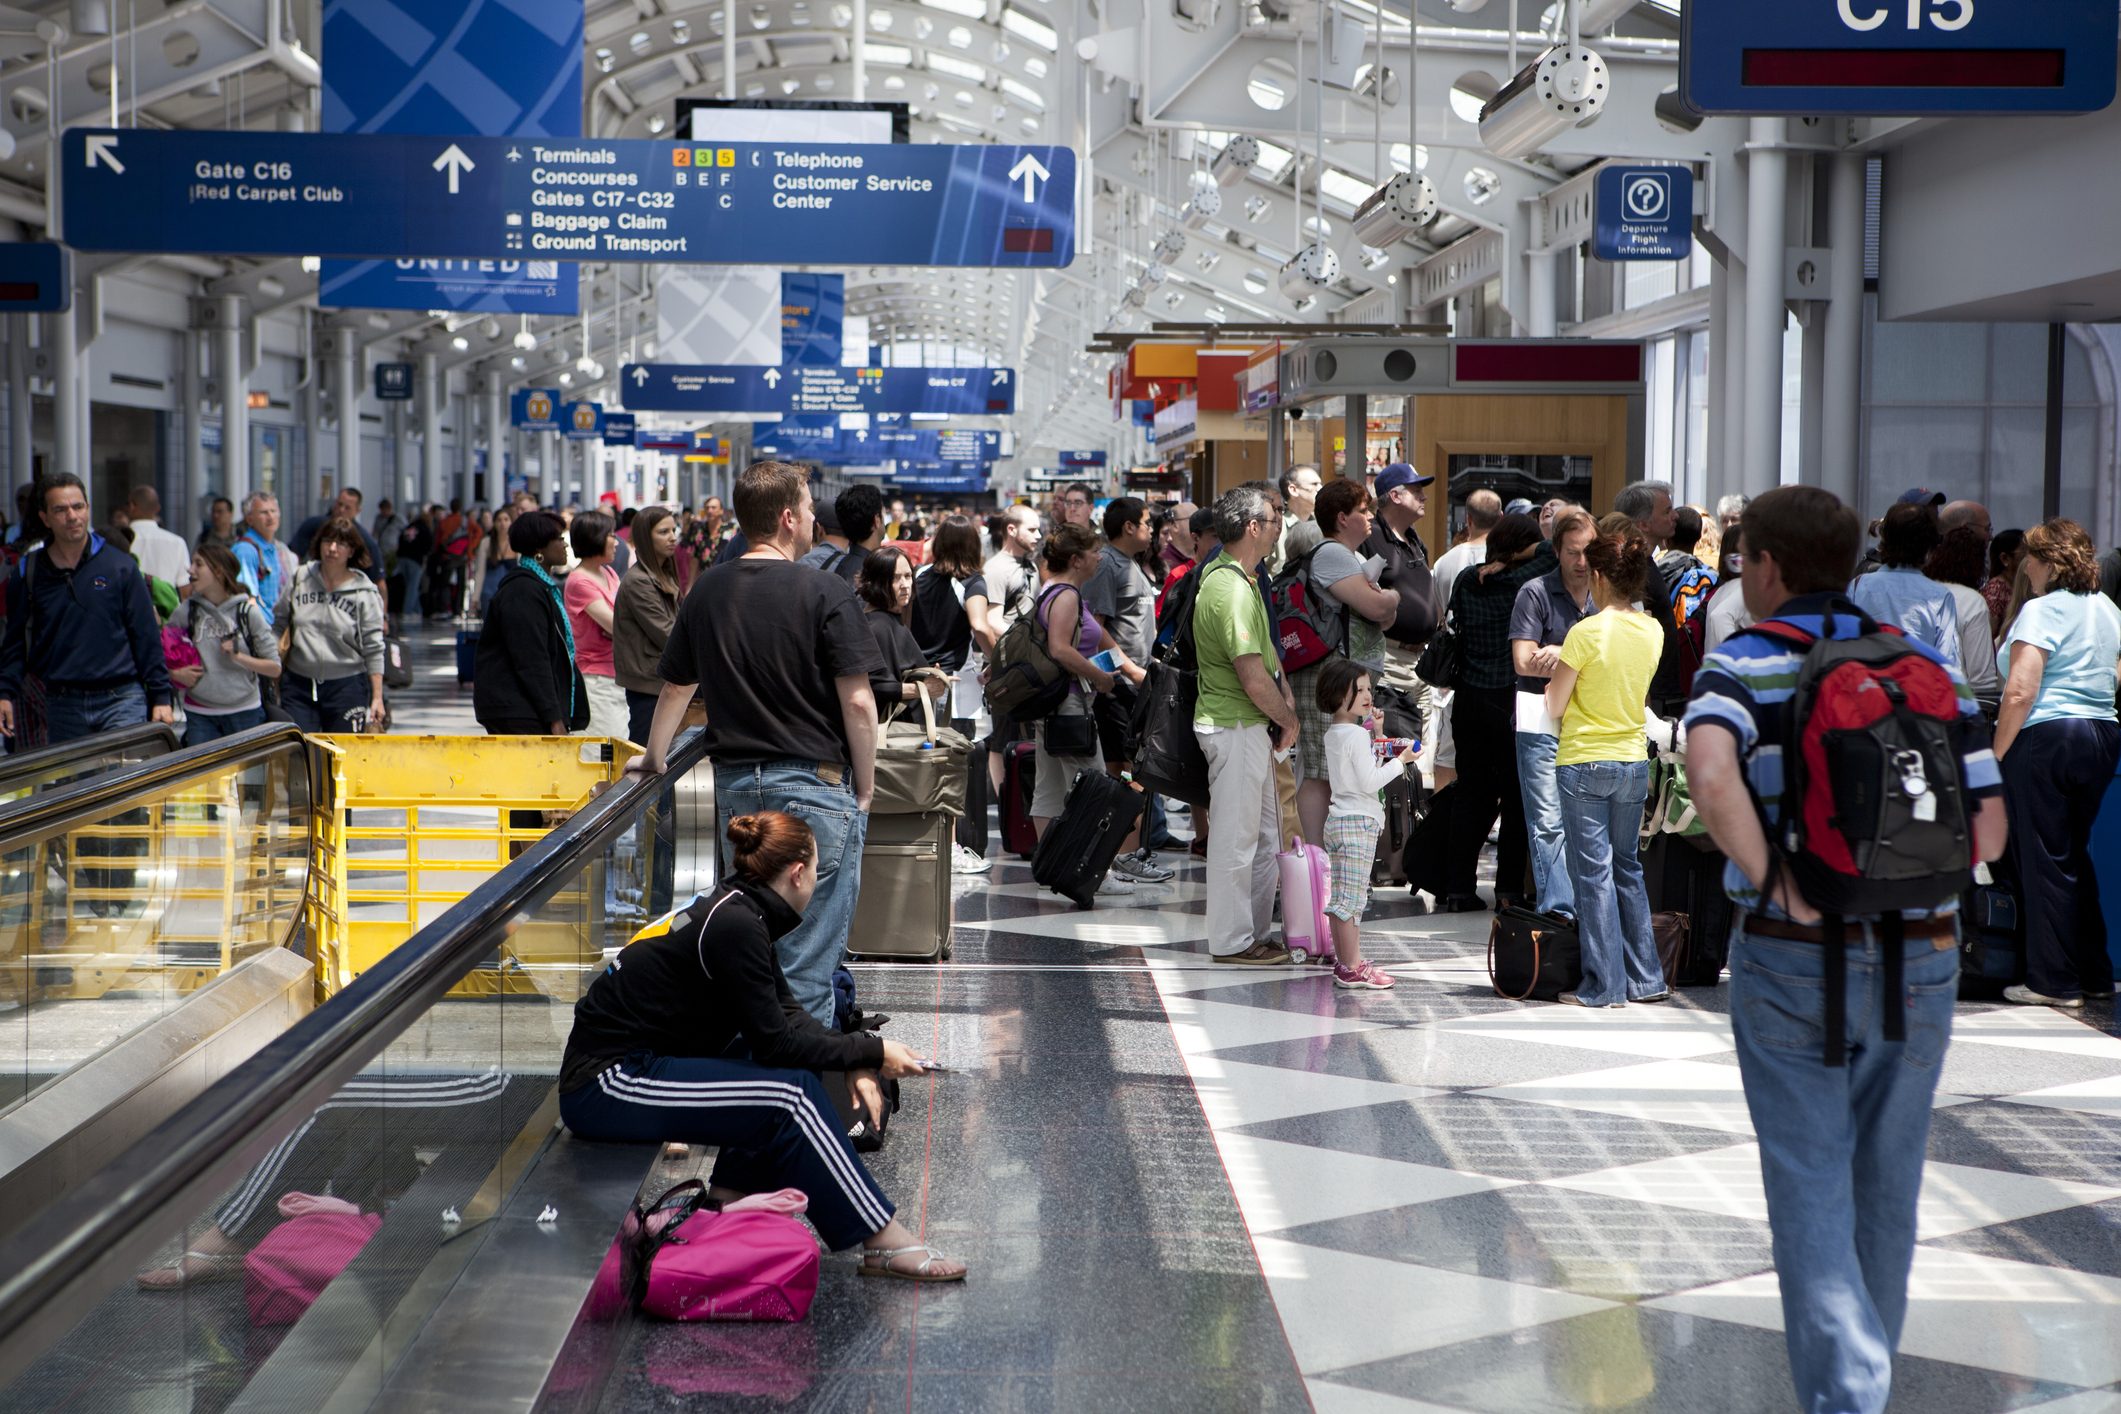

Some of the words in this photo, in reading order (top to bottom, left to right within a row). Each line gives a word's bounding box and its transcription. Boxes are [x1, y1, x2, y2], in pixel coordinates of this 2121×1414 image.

[1837, 0, 1974, 31] C15
[532, 147, 616, 164] Terminals
[677, 152, 686, 164] 2
[699, 152, 708, 164] 3
[721, 152, 731, 164] 5
[774, 151, 863, 170] Telephone
[195, 160, 245, 178] Gate
[253, 162, 292, 180] C16
[531, 168, 638, 186] Concourses
[676, 173, 687, 185] B
[698, 173, 709, 186] E
[720, 174, 731, 186] F
[773, 174, 859, 191] Customer
[866, 175, 932, 191] Service
[195, 184, 230, 199] Red
[236, 184, 297, 202] Carpet
[303, 185, 343, 201] Club
[531, 190, 585, 207] Gates
[592, 191, 675, 208] C17-C32
[719, 195, 732, 208] C
[773, 193, 832, 209] Center
[531, 211, 610, 231] Baggage
[617, 213, 667, 230] Claim
[1621, 224, 1668, 234] Departure
[531, 233, 596, 250] Ground
[603, 234, 687, 254] Transport
[1631, 235, 1658, 245] Flight
[1617, 246, 1672, 254] Information
[672, 375, 706, 383] Customer
[708, 376, 736, 384] Service
[677, 383, 702, 391] Center
[928, 377, 949, 387] Gate
